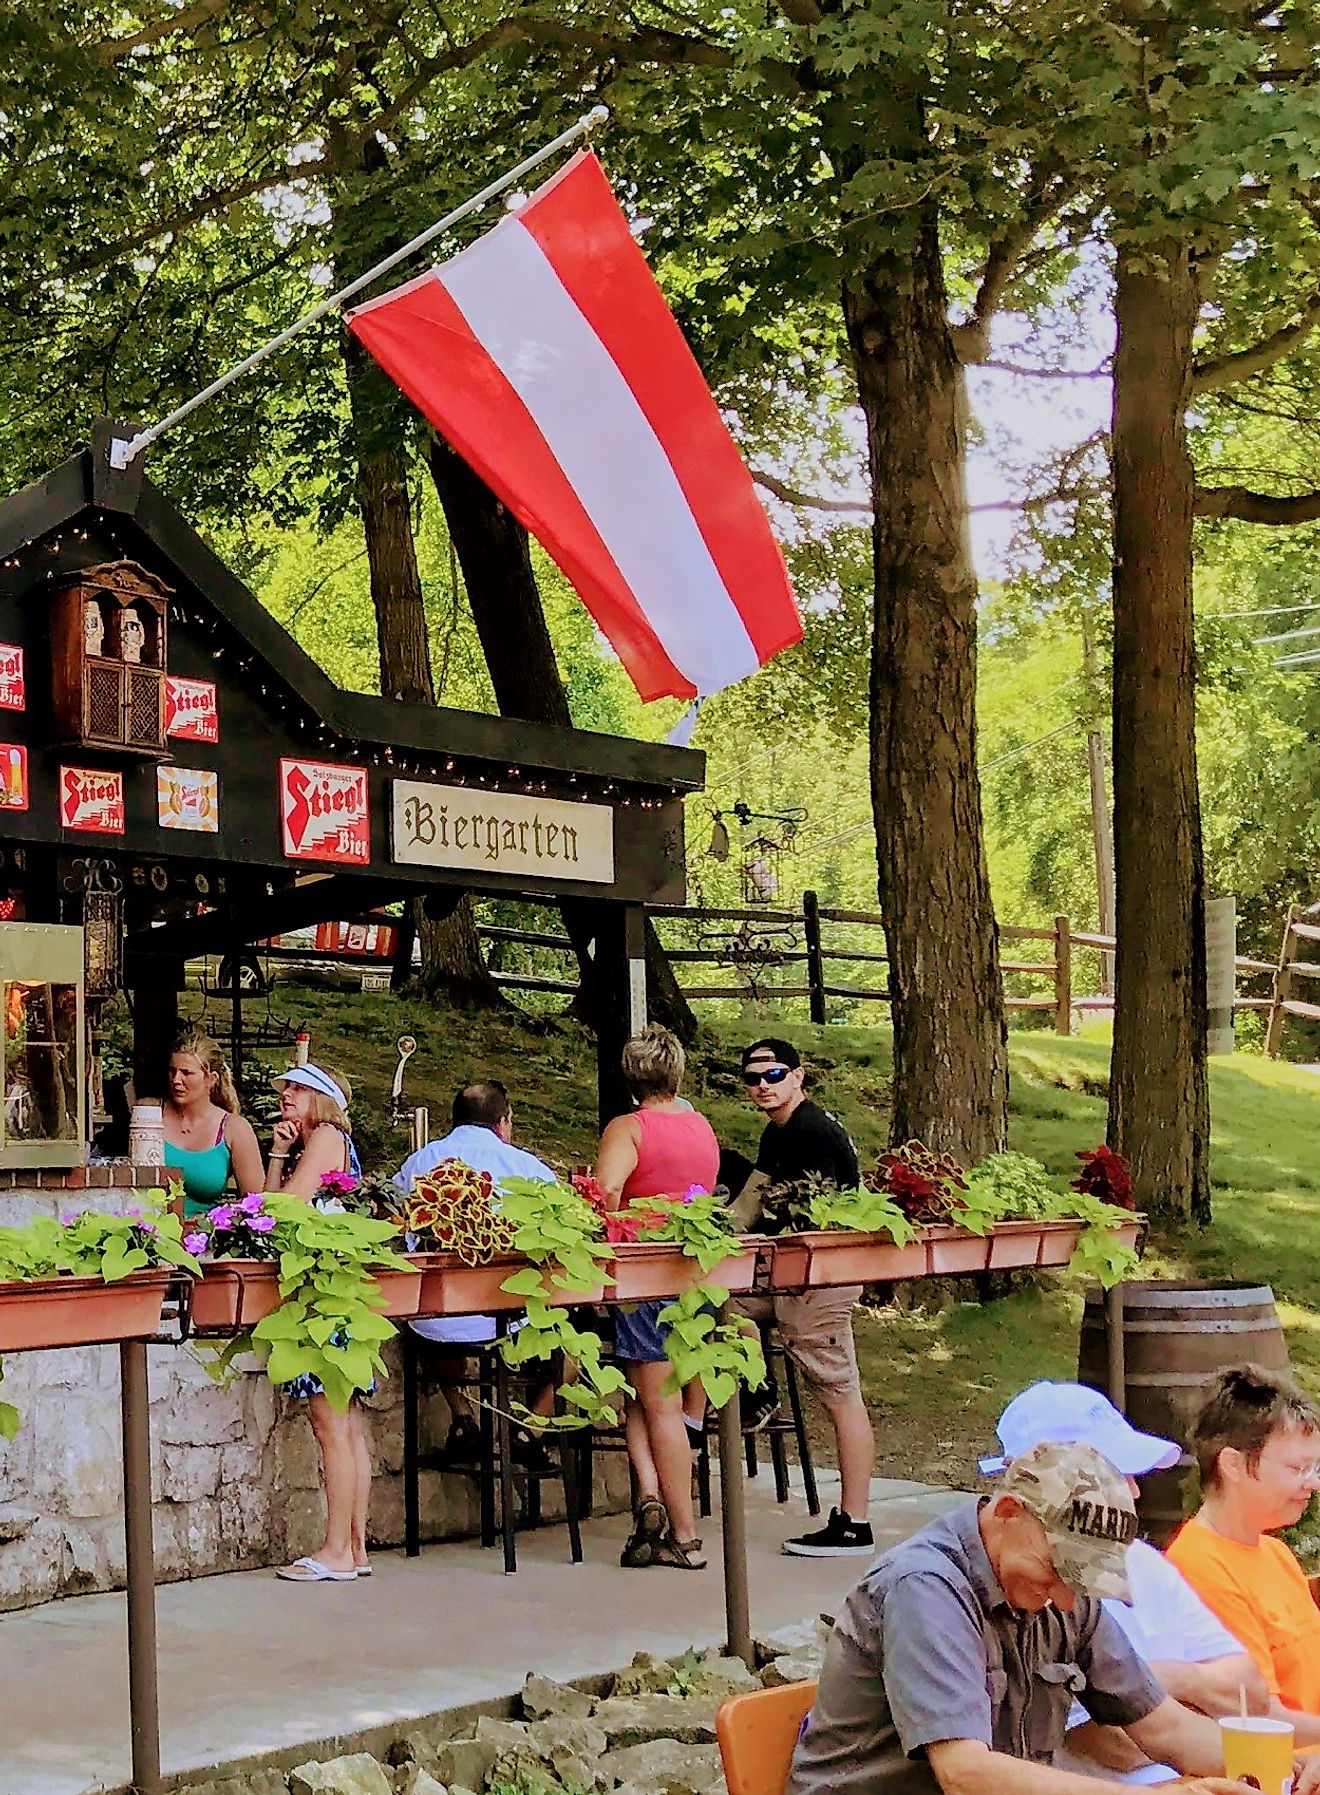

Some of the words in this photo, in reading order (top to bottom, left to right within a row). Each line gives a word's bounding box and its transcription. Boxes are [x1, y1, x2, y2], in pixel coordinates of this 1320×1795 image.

[64, 769, 120, 825] Stiegl
[98, 810, 124, 829] Bier
[287, 765, 364, 852] Stiegl
[334, 830, 367, 857] Bier
[404, 796, 579, 862] Biergarten
